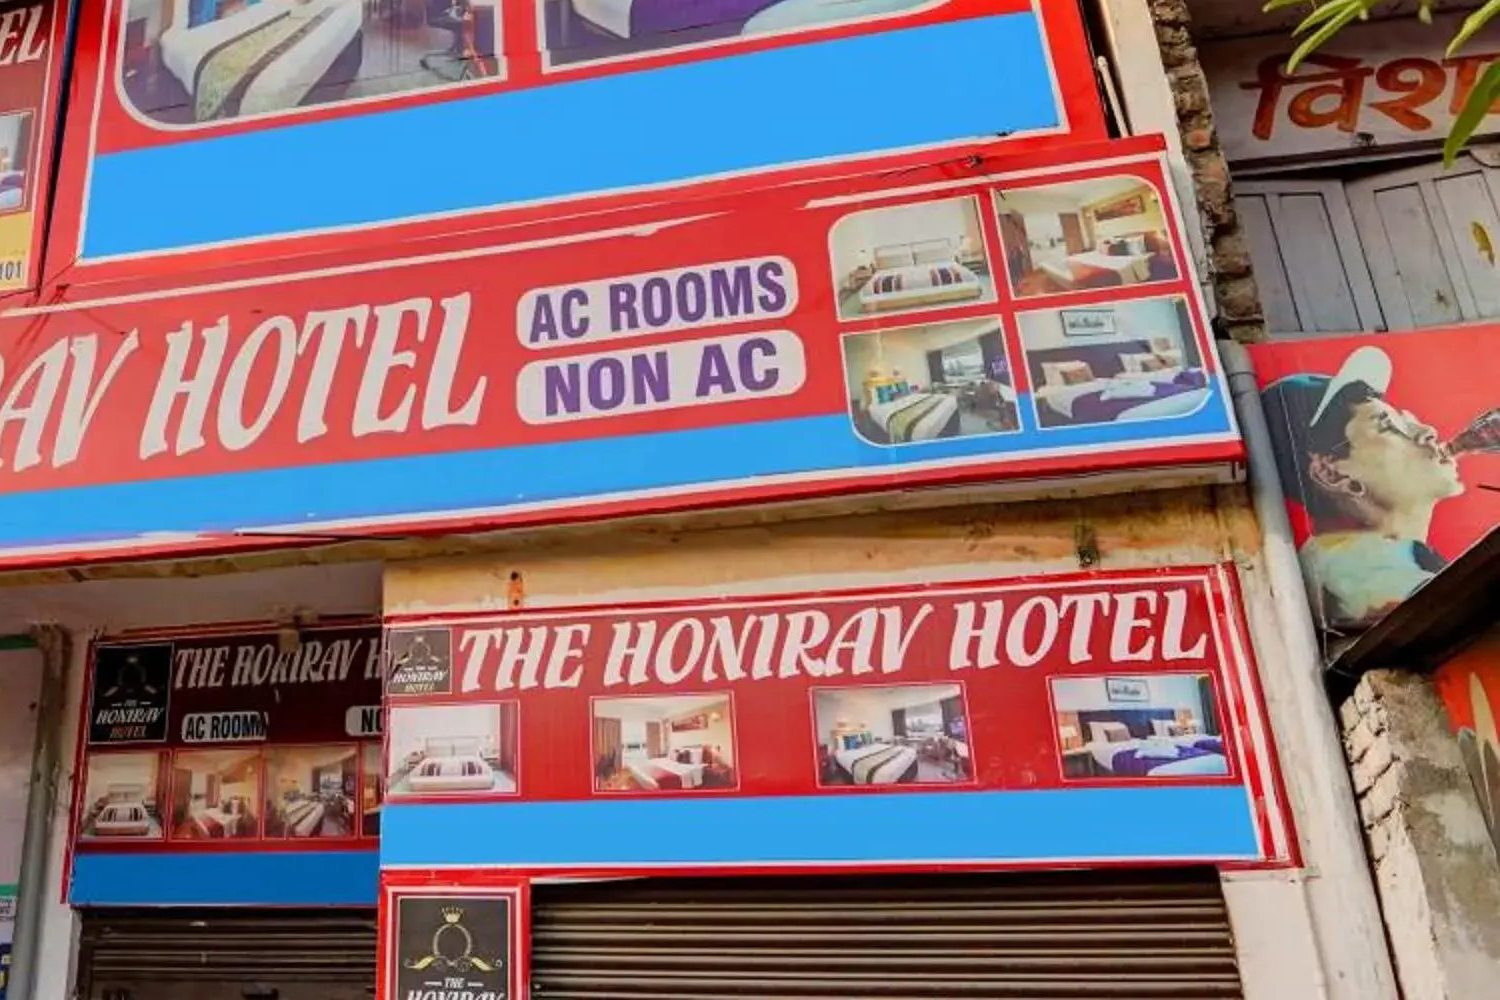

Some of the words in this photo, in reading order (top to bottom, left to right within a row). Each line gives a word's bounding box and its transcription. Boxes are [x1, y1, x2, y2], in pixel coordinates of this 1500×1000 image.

[528, 287, 591, 343] AC
[608, 261, 788, 335] ROOMS
[139, 292, 487, 461] HOTEL
[542, 353, 672, 416] NON
[694, 337, 780, 396] AC
[174, 646, 228, 689] THE
[459, 623, 591, 692] THE
[602, 603, 935, 686] HONIRAV
[950, 590, 1212, 670] HOTEL
[186, 717, 205, 740] AC
